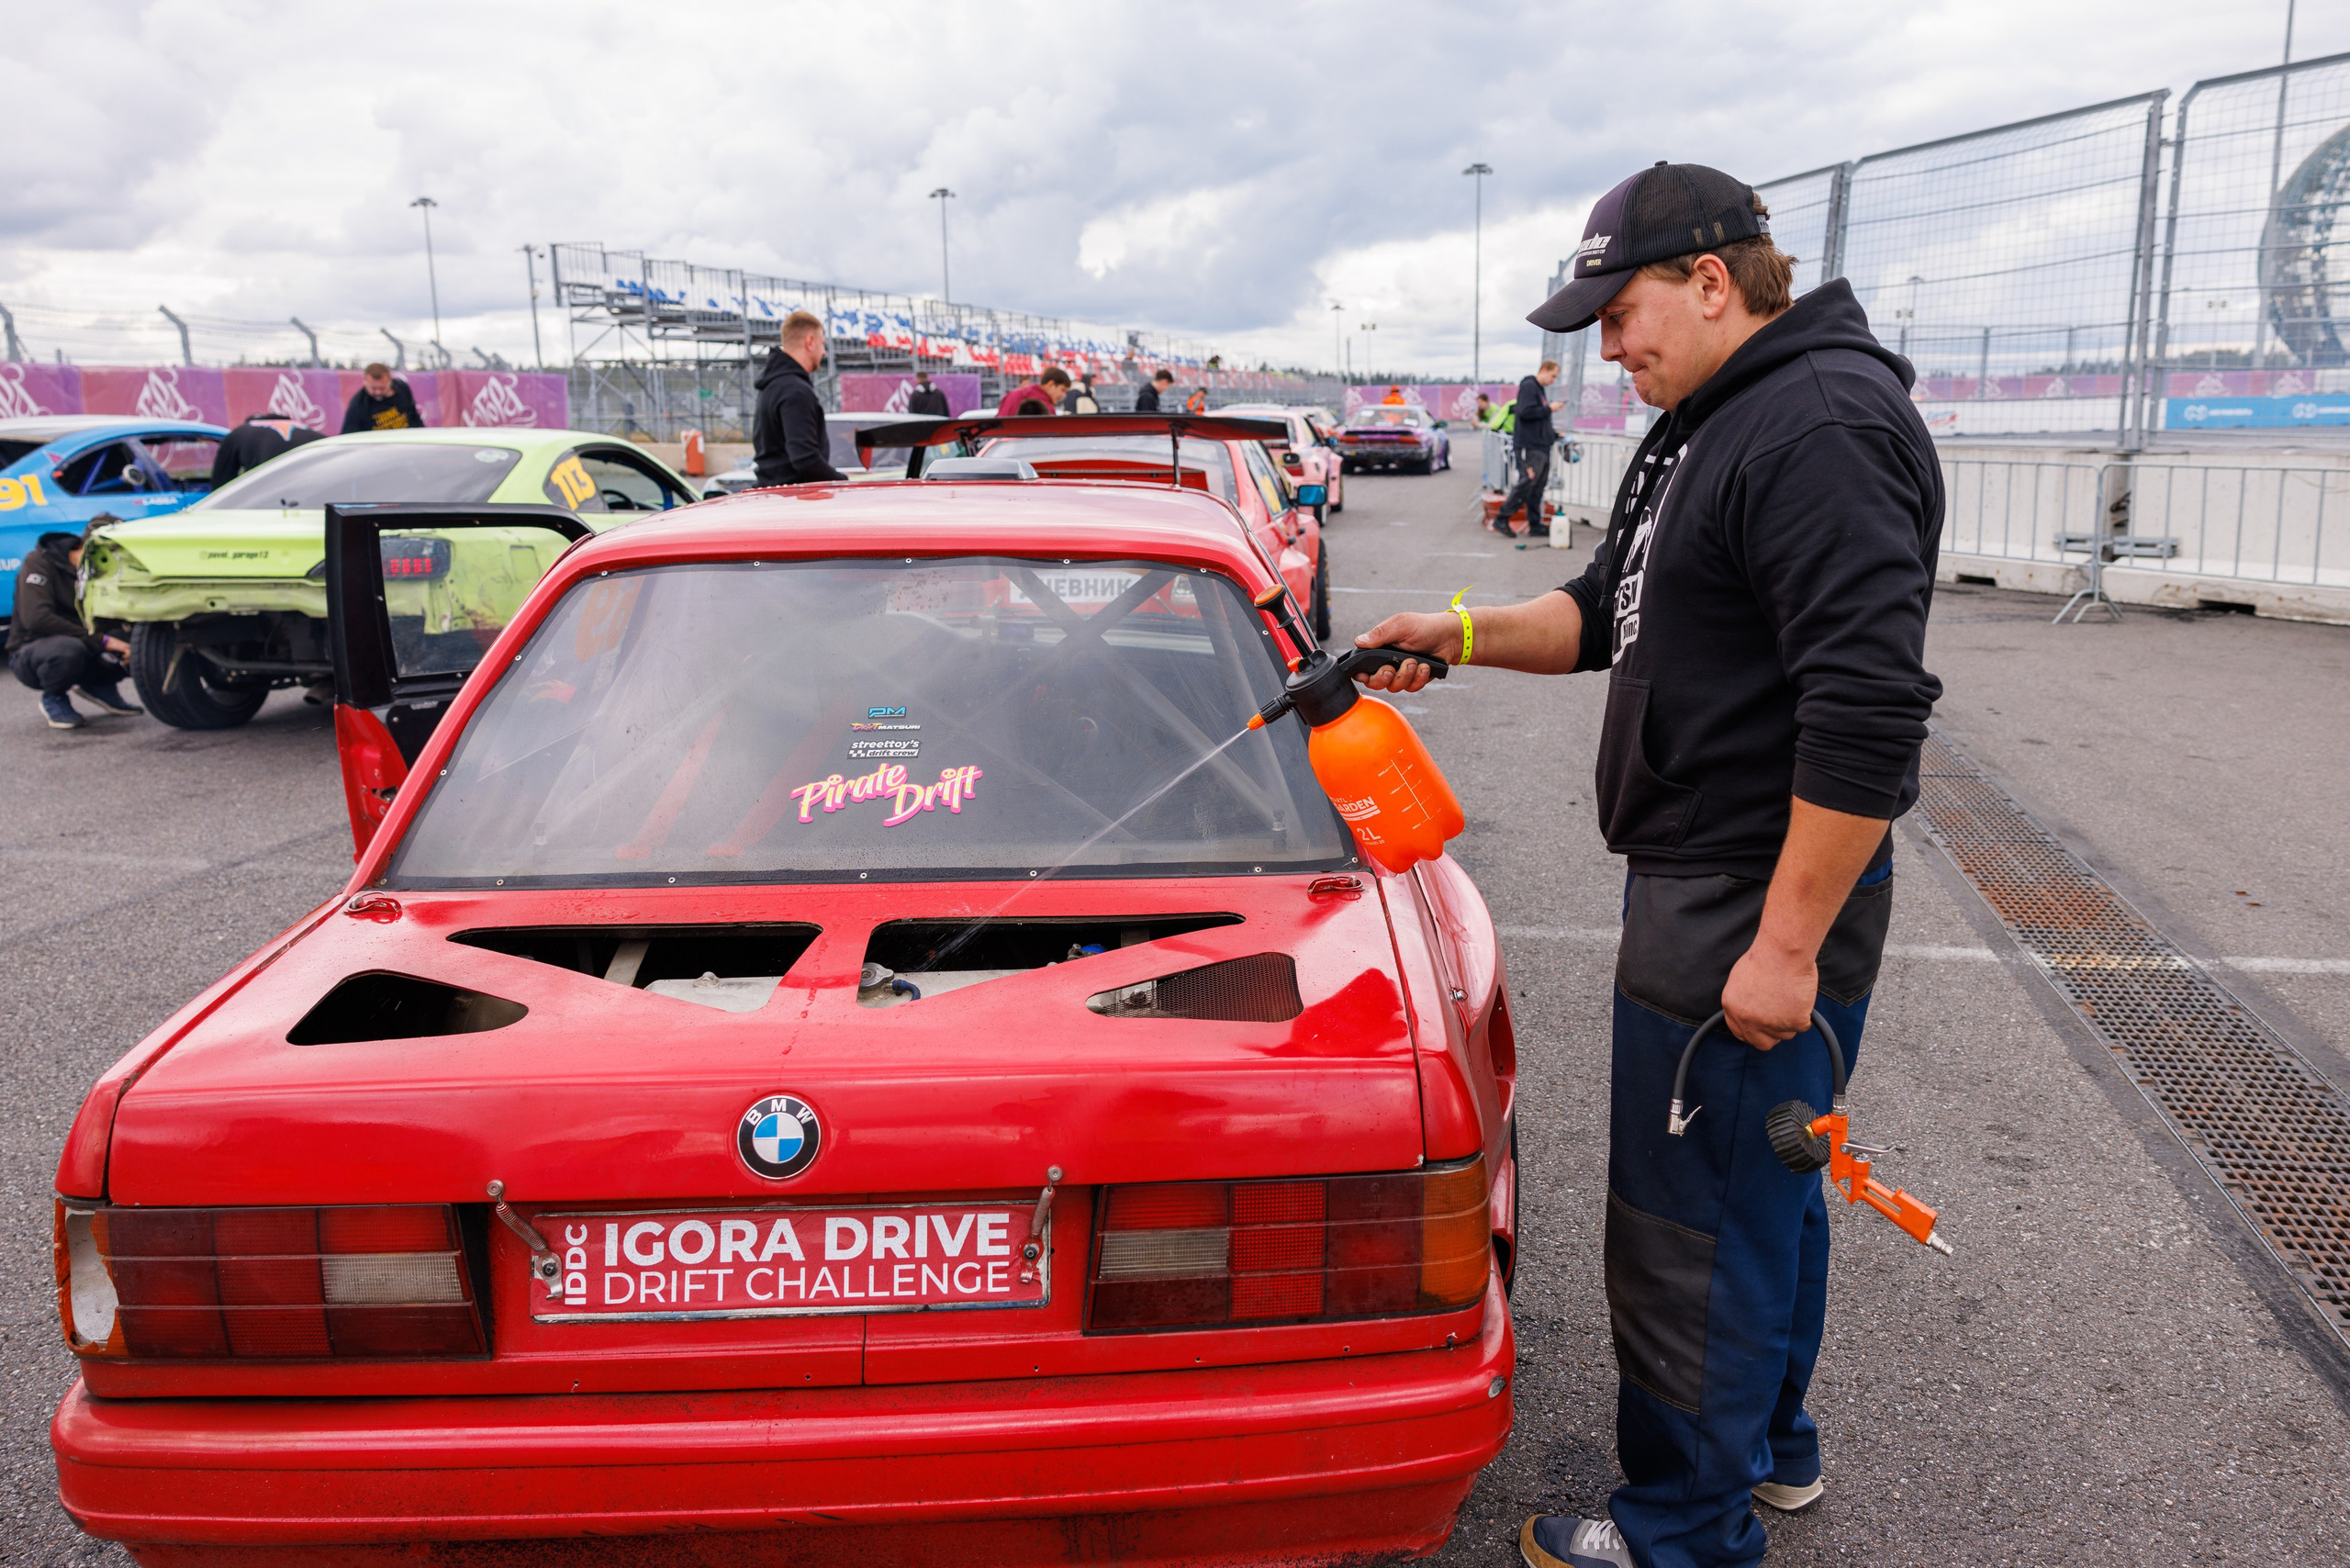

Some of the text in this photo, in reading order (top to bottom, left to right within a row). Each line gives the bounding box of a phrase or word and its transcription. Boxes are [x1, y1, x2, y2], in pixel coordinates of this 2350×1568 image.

[1586, 258, 1602, 267] DRIVER
[0, 474, 50, 511] 91
[550, 455, 597, 510] 113
[867, 706, 907, 718] PM
[851, 739, 921, 749] streettoy's
[868, 749, 891, 757] drift
[790, 763, 983, 827] Pirate Drift
[1356, 826, 1382, 841] 2L
[744, 1098, 815, 1126] BMW
[604, 1213, 1011, 1267] IGORA DRIVE
[565, 1224, 588, 1305] IDDC
[604, 1260, 1011, 1305] DRIFT CHALLENGE
